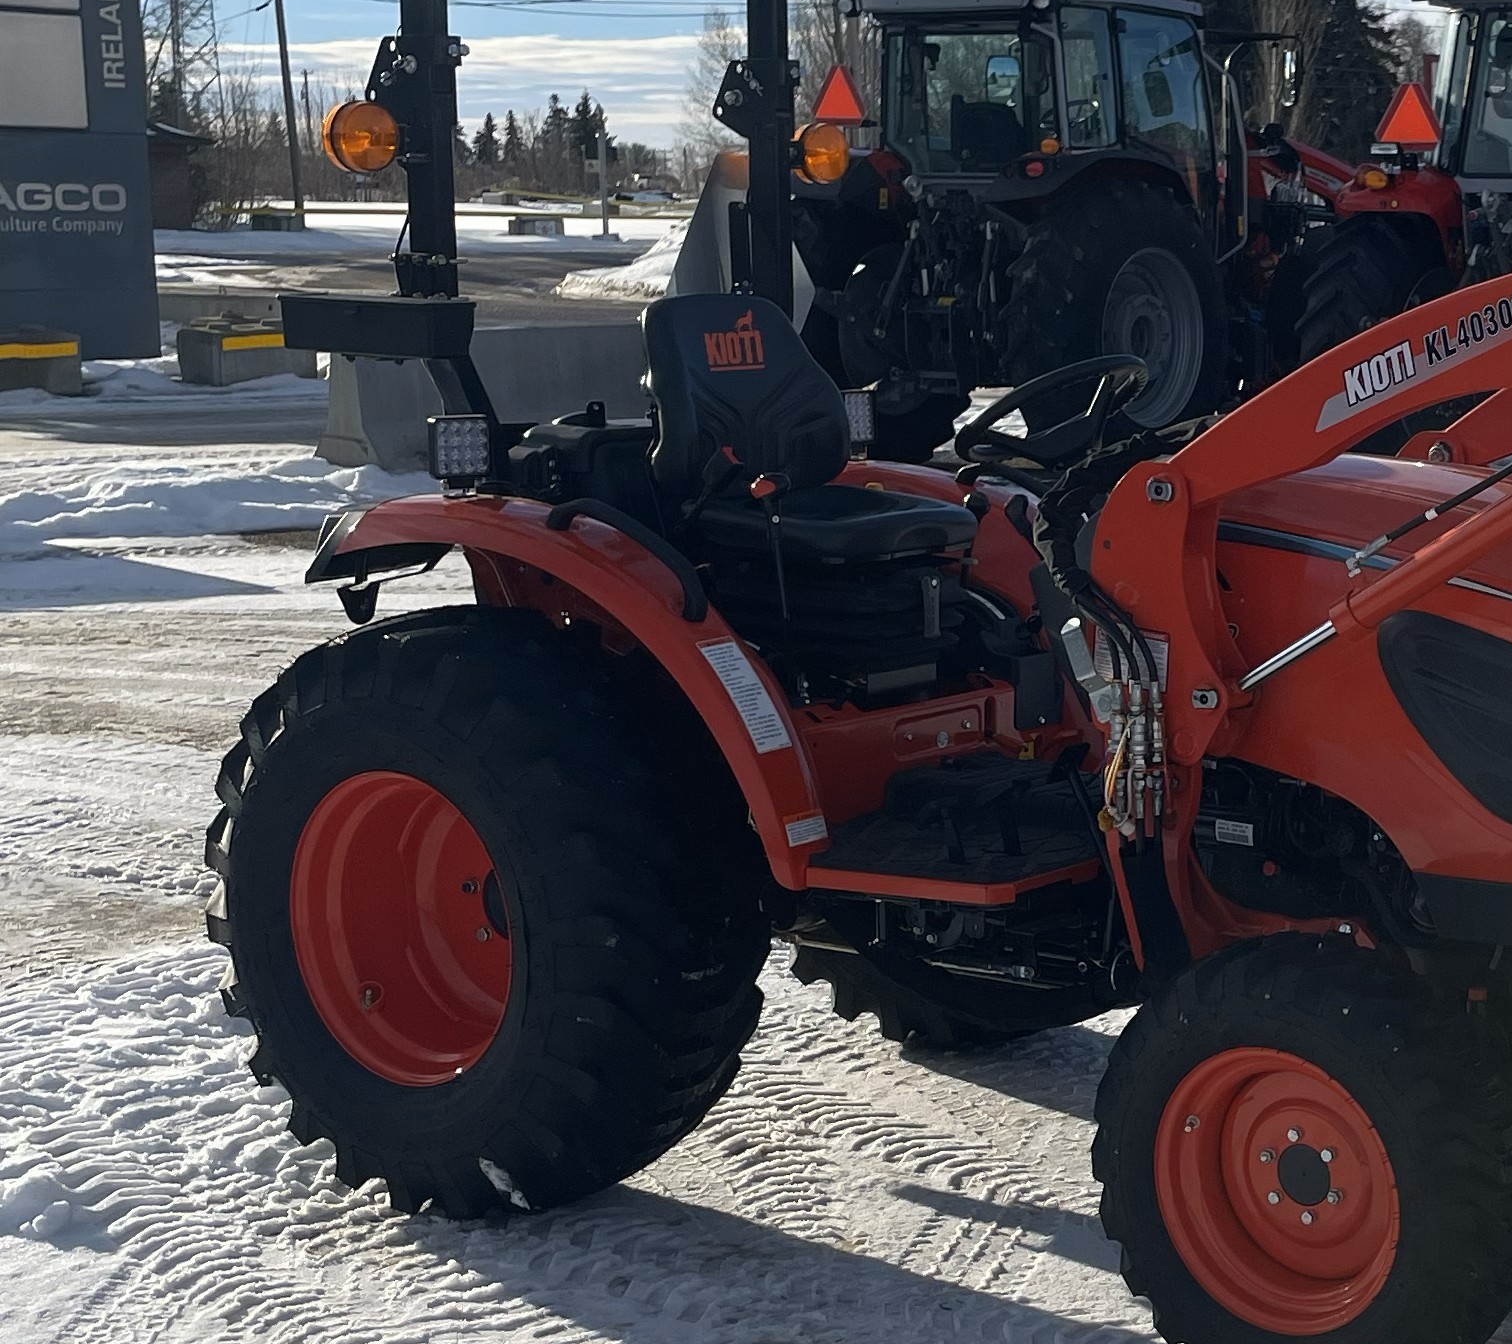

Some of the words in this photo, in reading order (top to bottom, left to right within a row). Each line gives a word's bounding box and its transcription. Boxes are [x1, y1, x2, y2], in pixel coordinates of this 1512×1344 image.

[52, 216, 124, 235] Company
[704, 329, 764, 366] KIOTI
[1343, 340, 1416, 406] KIOTI
